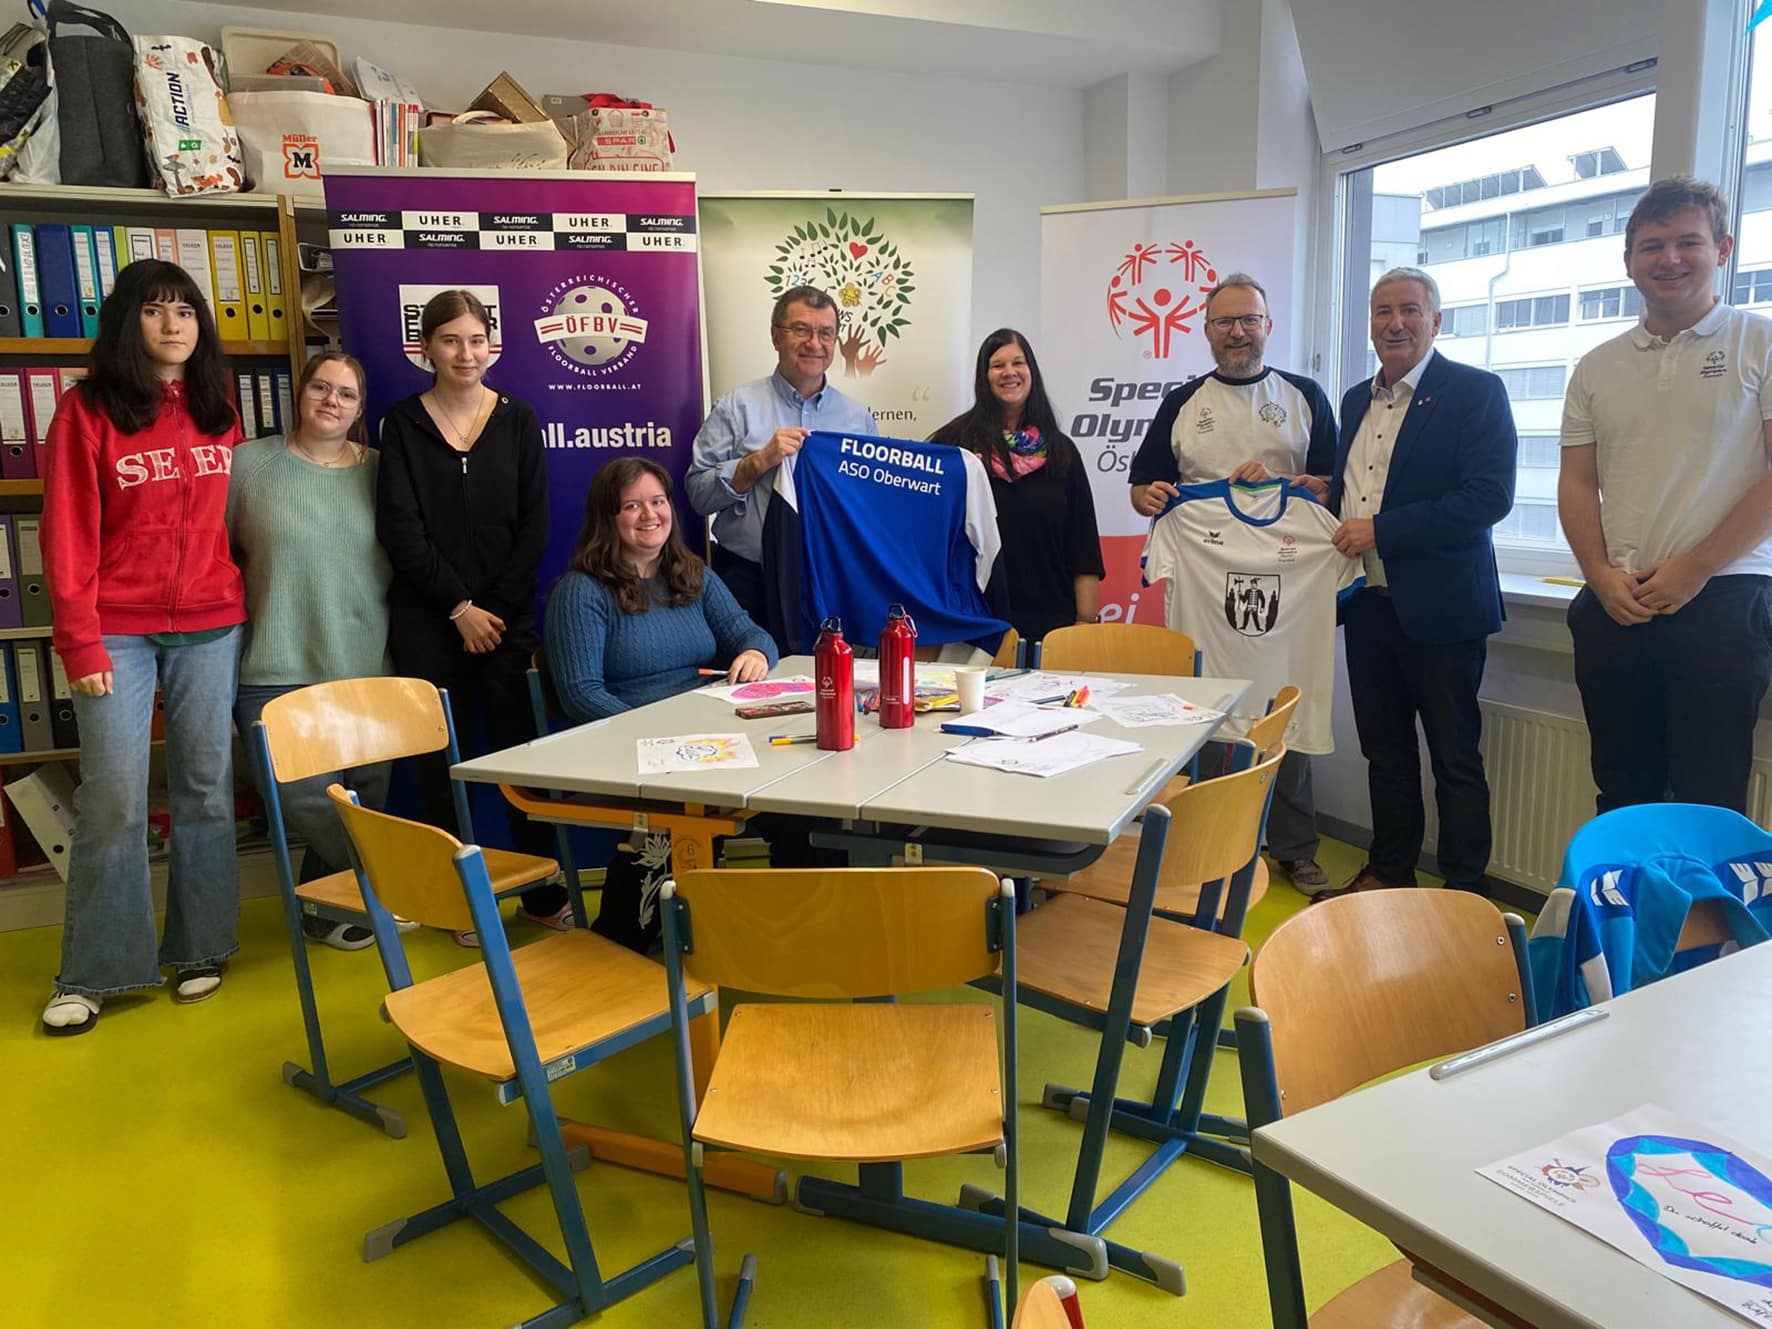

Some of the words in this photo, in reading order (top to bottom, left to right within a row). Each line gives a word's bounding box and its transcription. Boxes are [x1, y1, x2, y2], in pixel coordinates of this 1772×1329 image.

[166, 72, 190, 127] ACTION
[283, 134, 318, 142] Müller
[419, 215, 461, 226] UHER
[569, 217, 609, 228] UHER
[343, 233, 386, 243] UHER
[496, 235, 537, 245] UHER
[642, 237, 682, 247] UHER
[565, 315, 618, 334] ÖFBV
[547, 345, 597, 377] FLOORBALL
[840, 437, 945, 475] FLOORBALL
[838, 460, 870, 480] ASO
[873, 468, 942, 496] Oberwart
